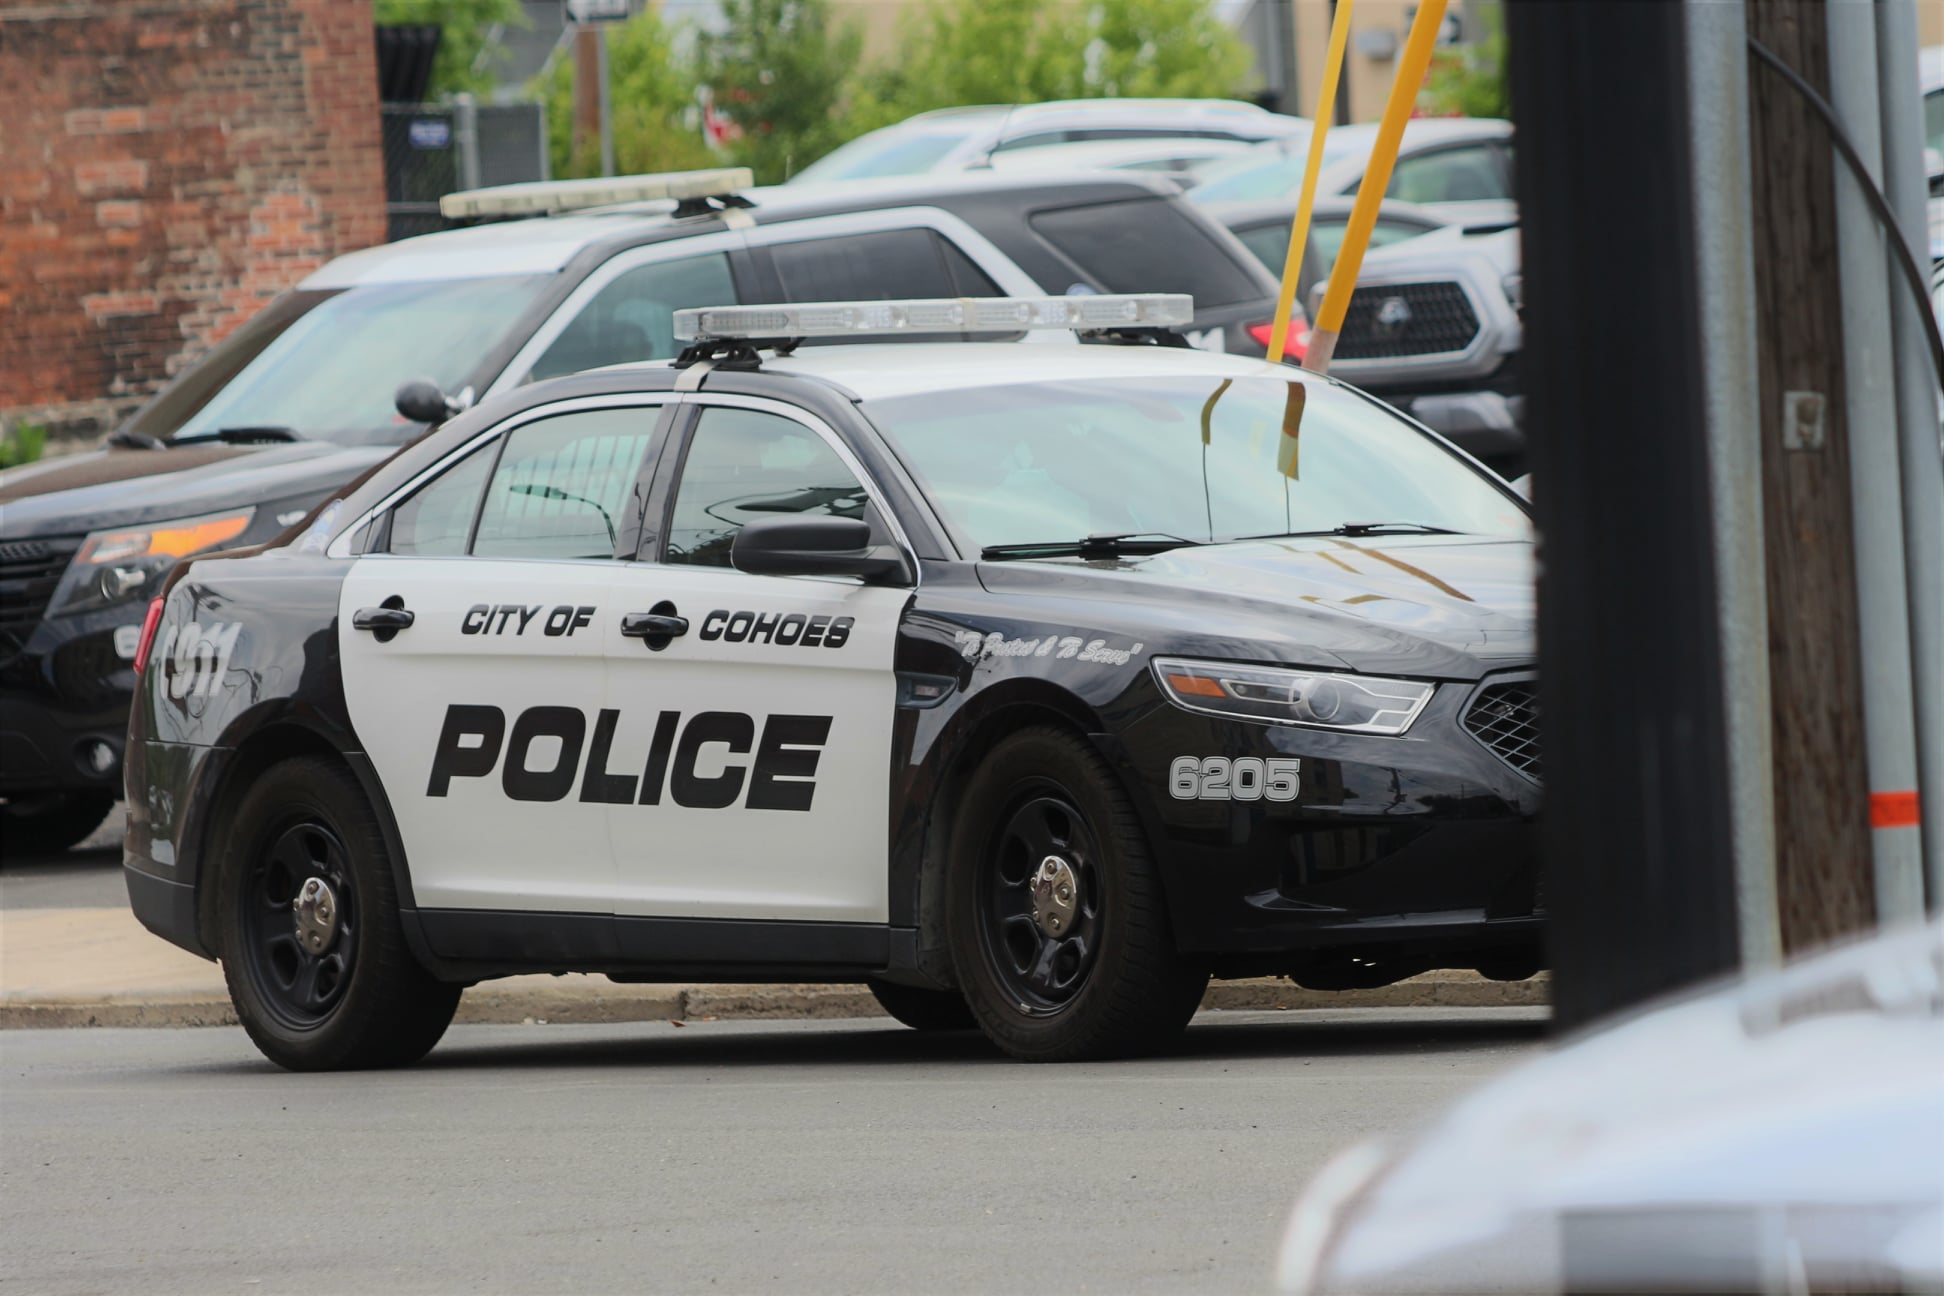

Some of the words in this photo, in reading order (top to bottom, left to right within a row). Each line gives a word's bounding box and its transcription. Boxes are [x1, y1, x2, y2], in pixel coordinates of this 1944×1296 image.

[461, 603, 543, 636] CITY
[543, 605, 597, 637] OF
[699, 609, 855, 649] COHOES
[426, 703, 834, 812] POLICE
[1168, 755, 1300, 801] 6205
